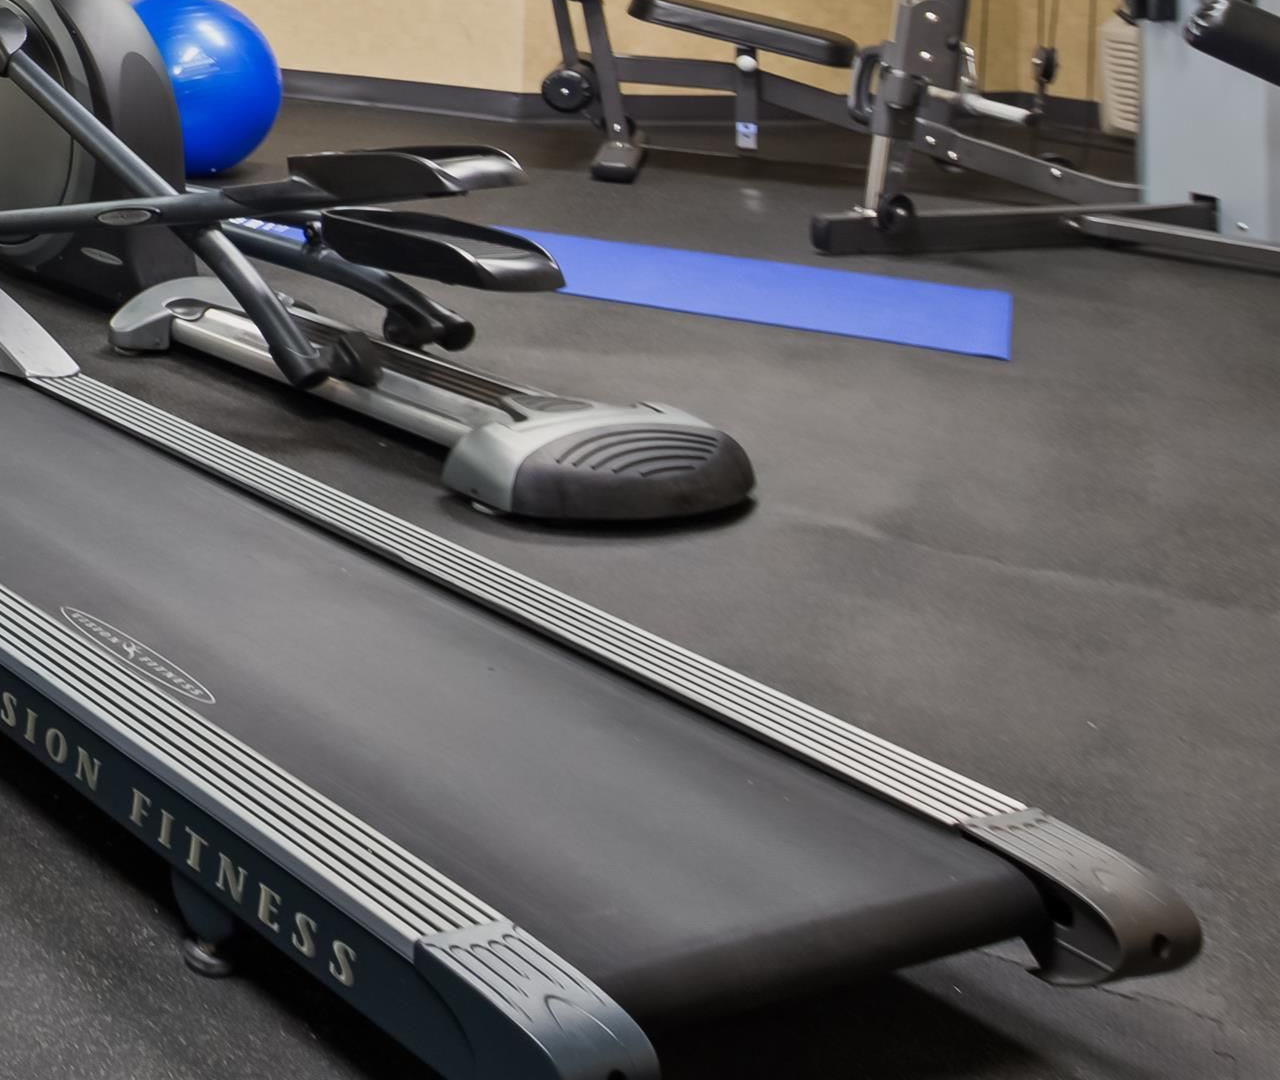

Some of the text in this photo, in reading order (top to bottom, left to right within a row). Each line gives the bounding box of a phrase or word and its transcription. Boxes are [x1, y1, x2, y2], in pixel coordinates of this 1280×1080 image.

[71, 612, 205, 696] VISION FITNESS
[128, 786, 358, 987] FITNESS
